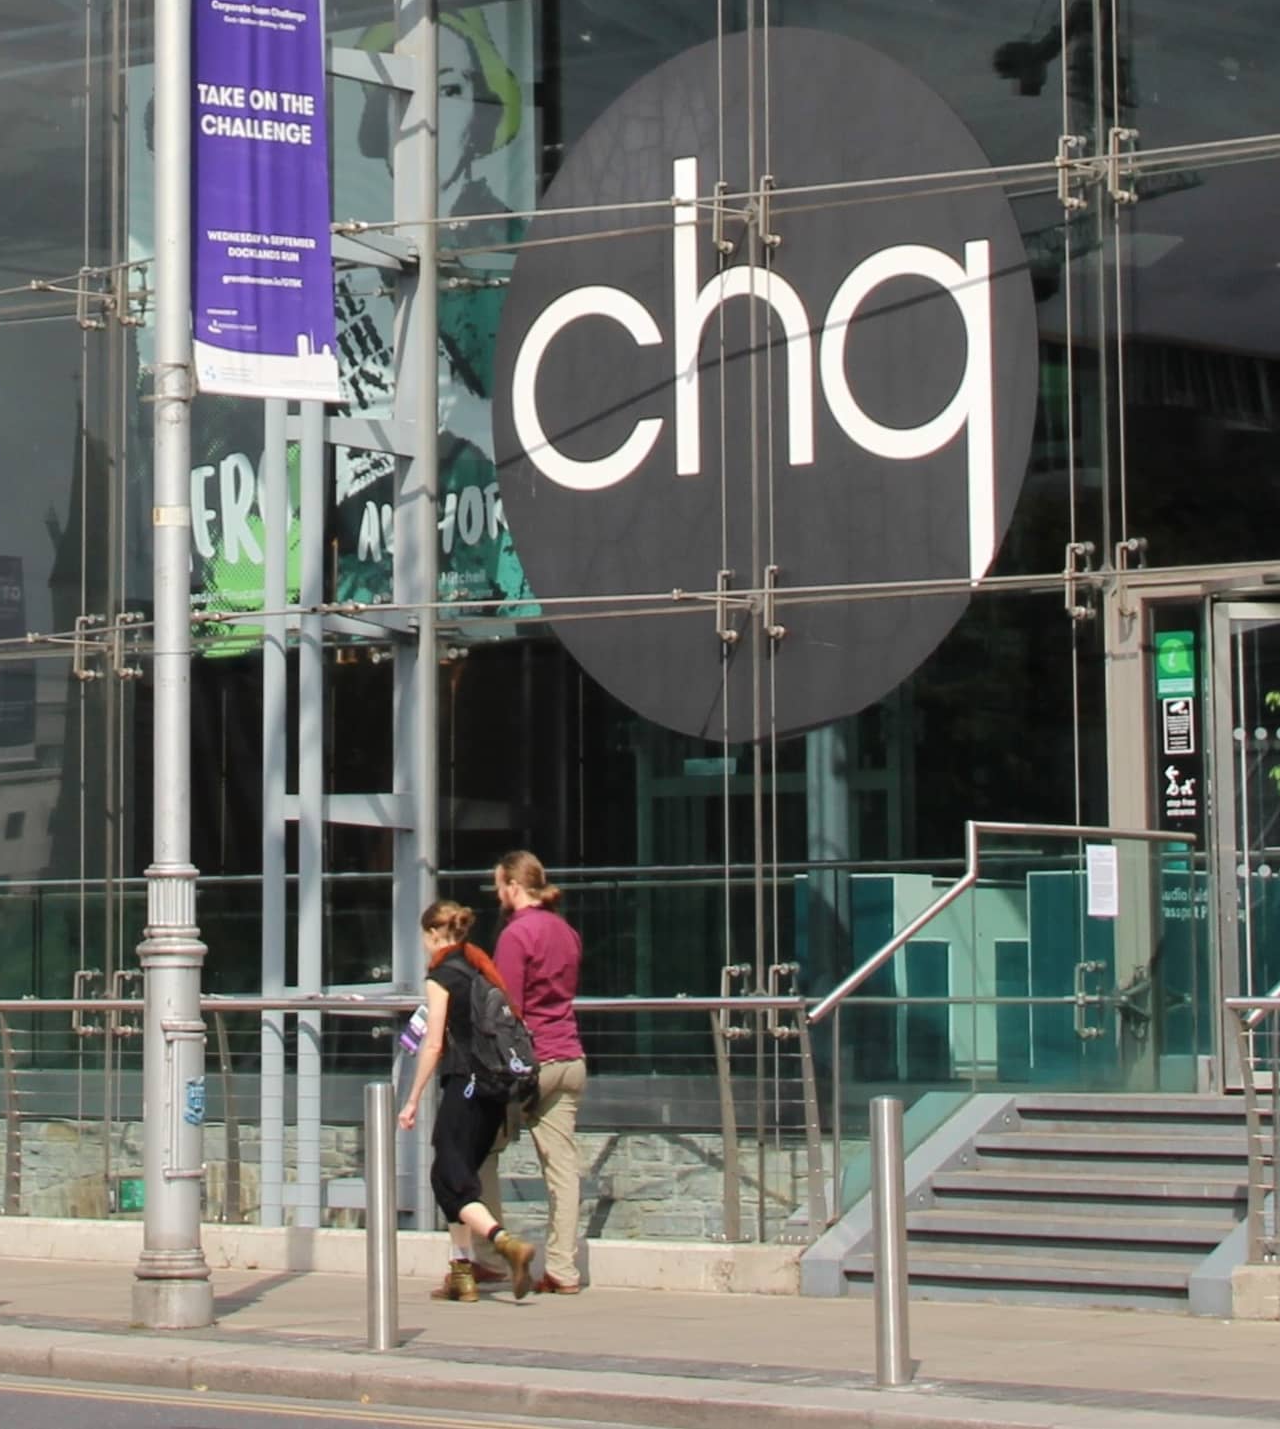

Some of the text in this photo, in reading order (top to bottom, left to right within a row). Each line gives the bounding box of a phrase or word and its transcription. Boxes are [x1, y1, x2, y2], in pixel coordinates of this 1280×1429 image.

[197, 83, 315, 116] TAKE ON THE
[201, 113, 312, 145] CHALLENGE
[207, 230, 261, 244] WEDNESDAY
[270, 234, 316, 249] SEPTEMBER
[228, 246, 300, 262] DOCKLANDS RUN
[512, 155, 996, 587] chq
